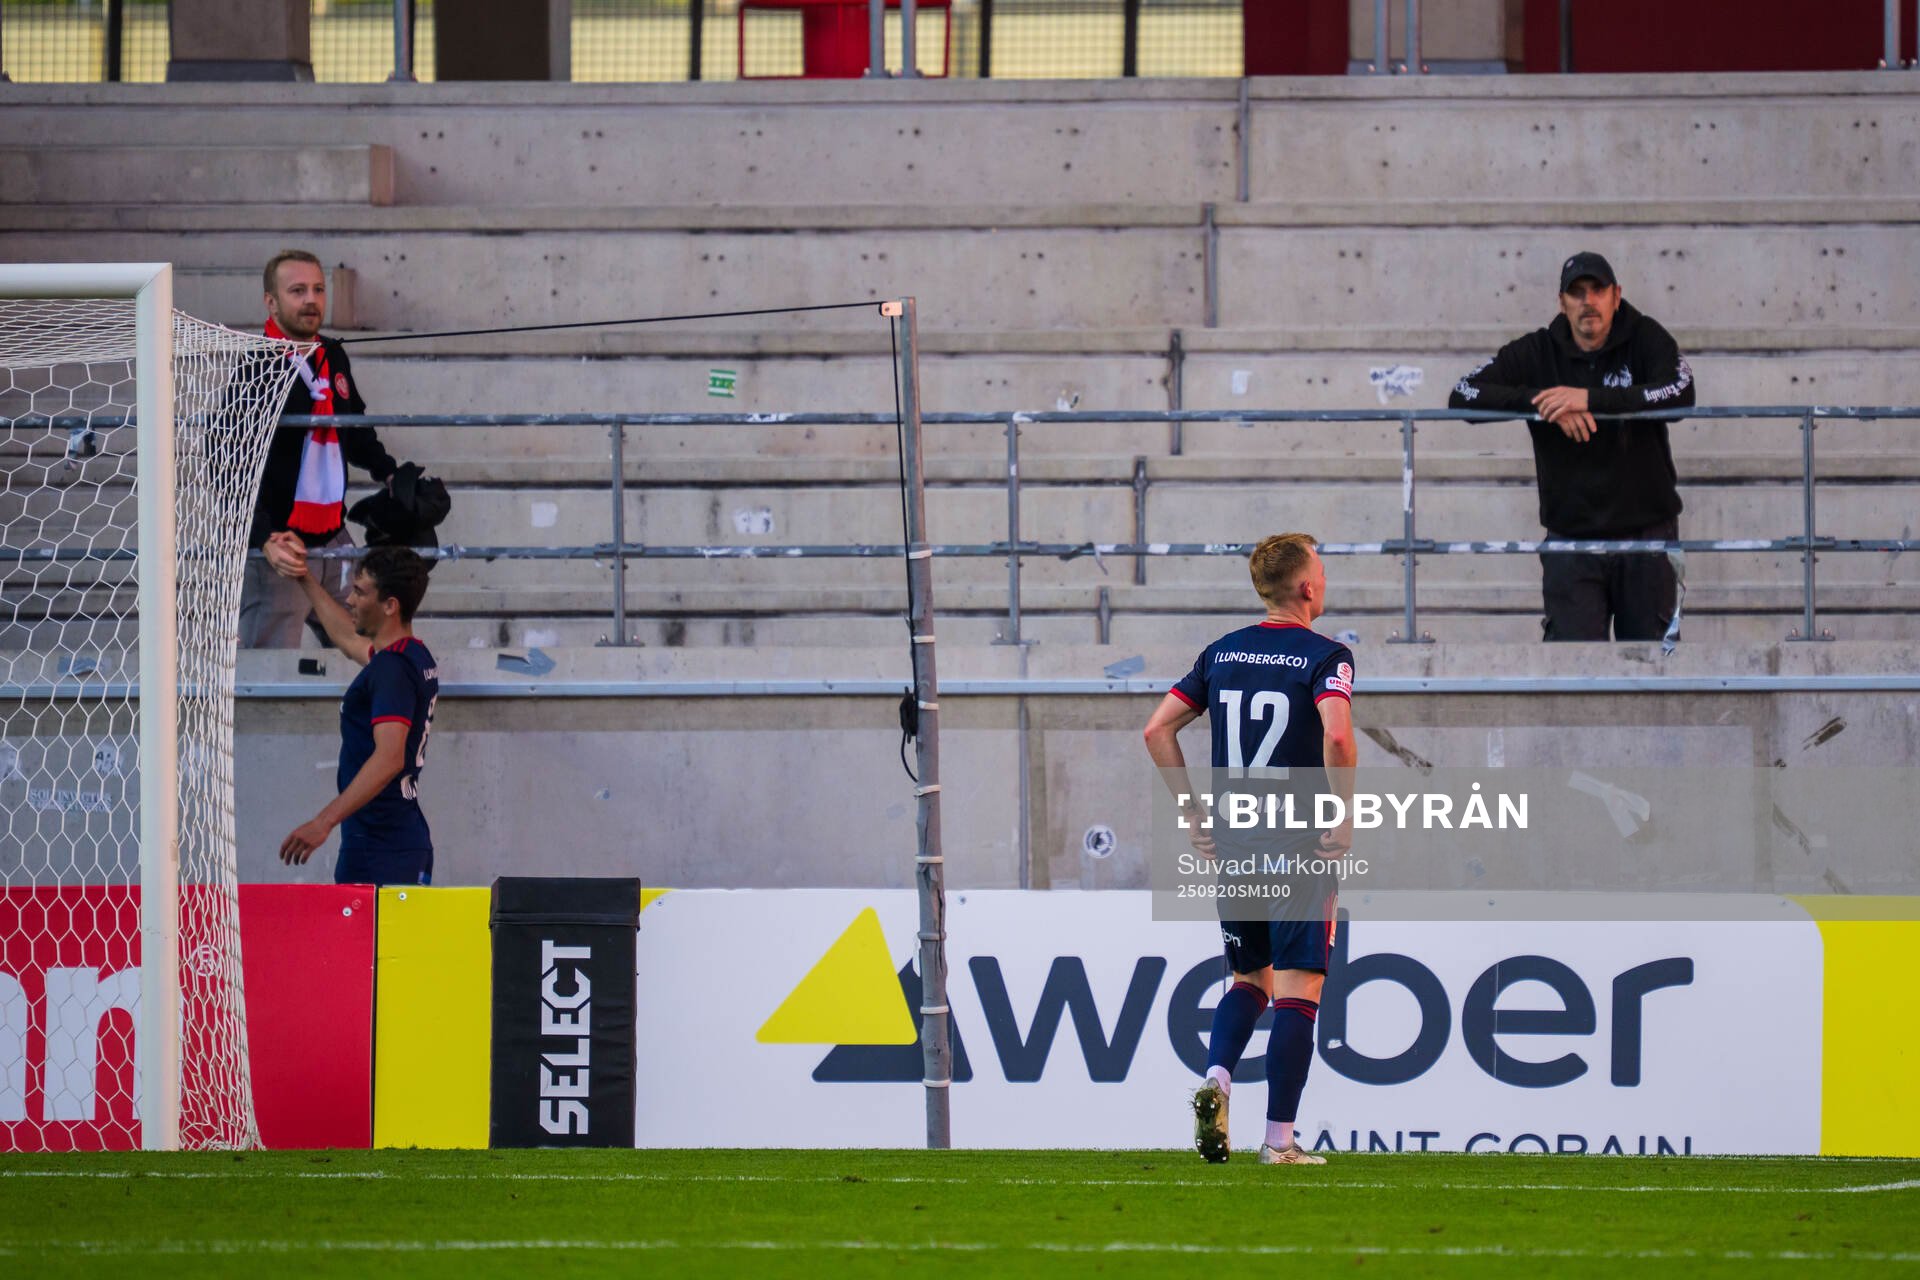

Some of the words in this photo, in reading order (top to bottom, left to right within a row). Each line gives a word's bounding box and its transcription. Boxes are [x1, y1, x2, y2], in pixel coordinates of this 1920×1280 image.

[1214, 651, 1308, 669] (LUNDBERG&CO)
[1219, 689, 1290, 780] 12
[539, 939, 592, 1135] SELECT
[968, 906, 1695, 1089] weber
[1293, 1129, 1441, 1153] AINT
